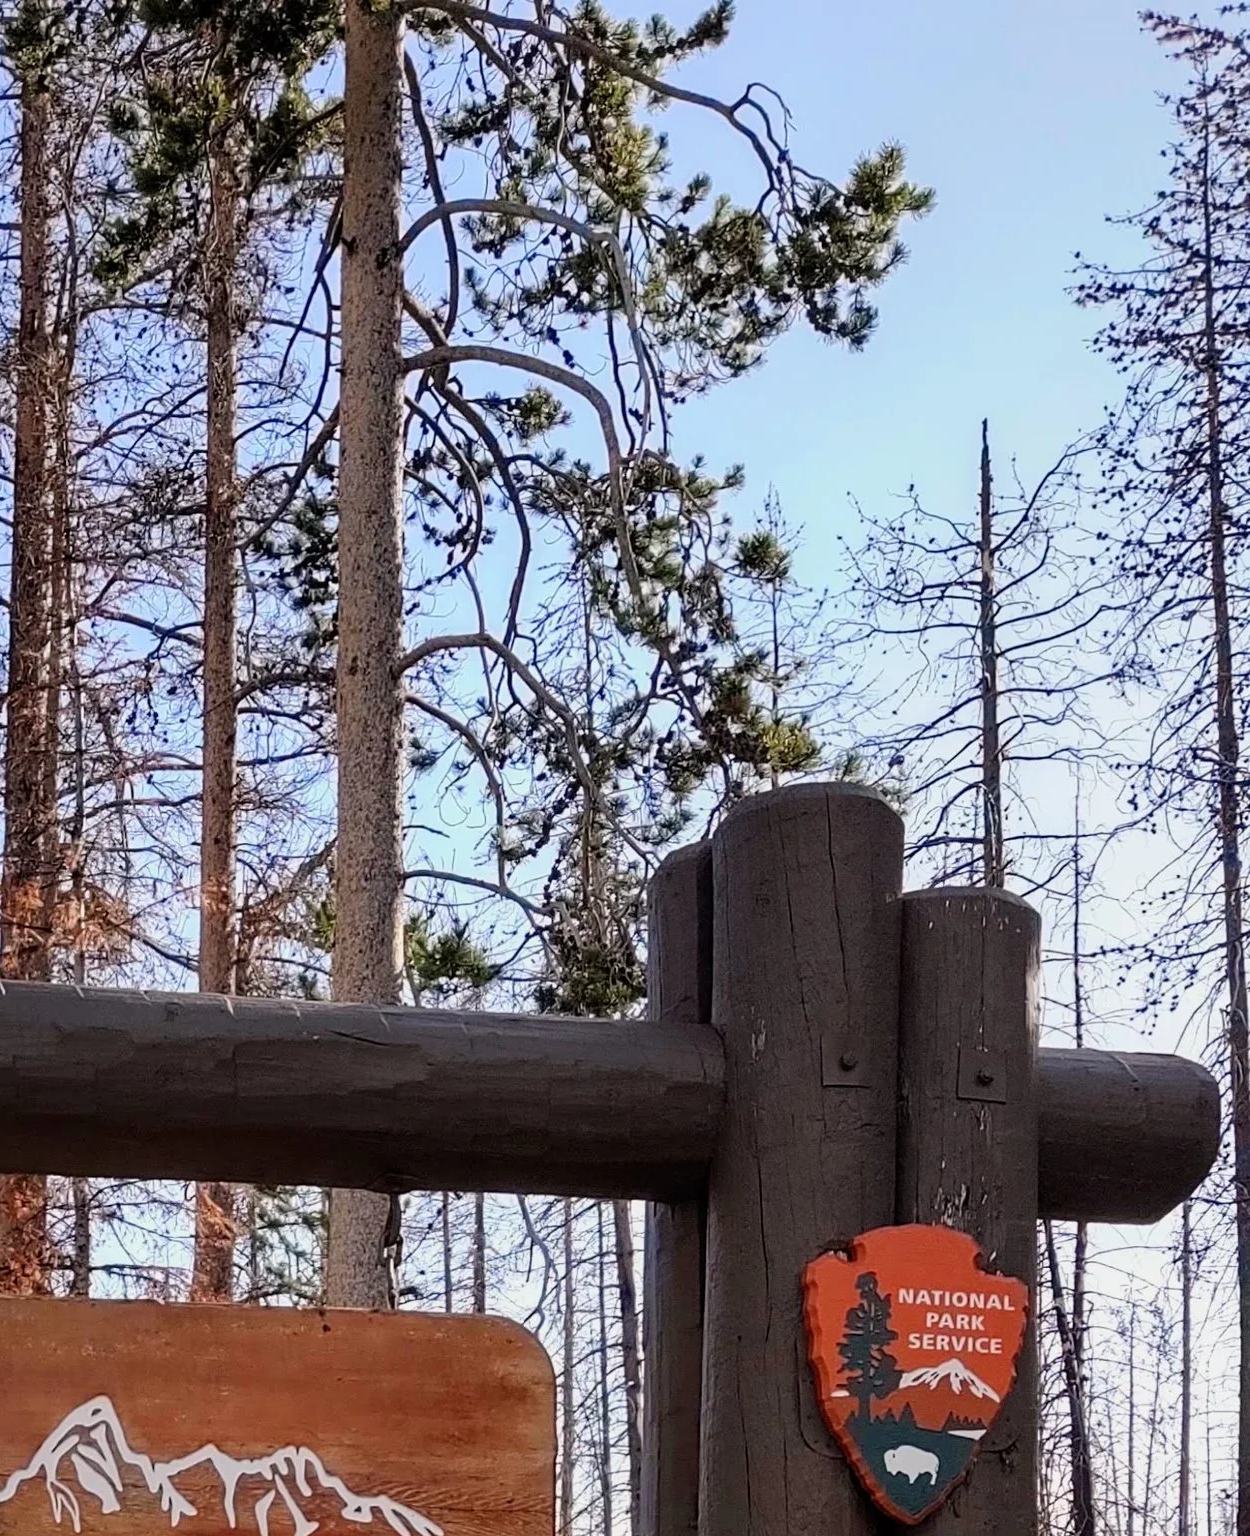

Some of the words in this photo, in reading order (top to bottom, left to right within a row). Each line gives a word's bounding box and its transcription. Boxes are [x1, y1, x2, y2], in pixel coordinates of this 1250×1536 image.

[898, 1288, 1015, 1311] NATIONAL
[925, 1311, 985, 1331] PARK
[908, 1333, 1003, 1354] SERVICE
